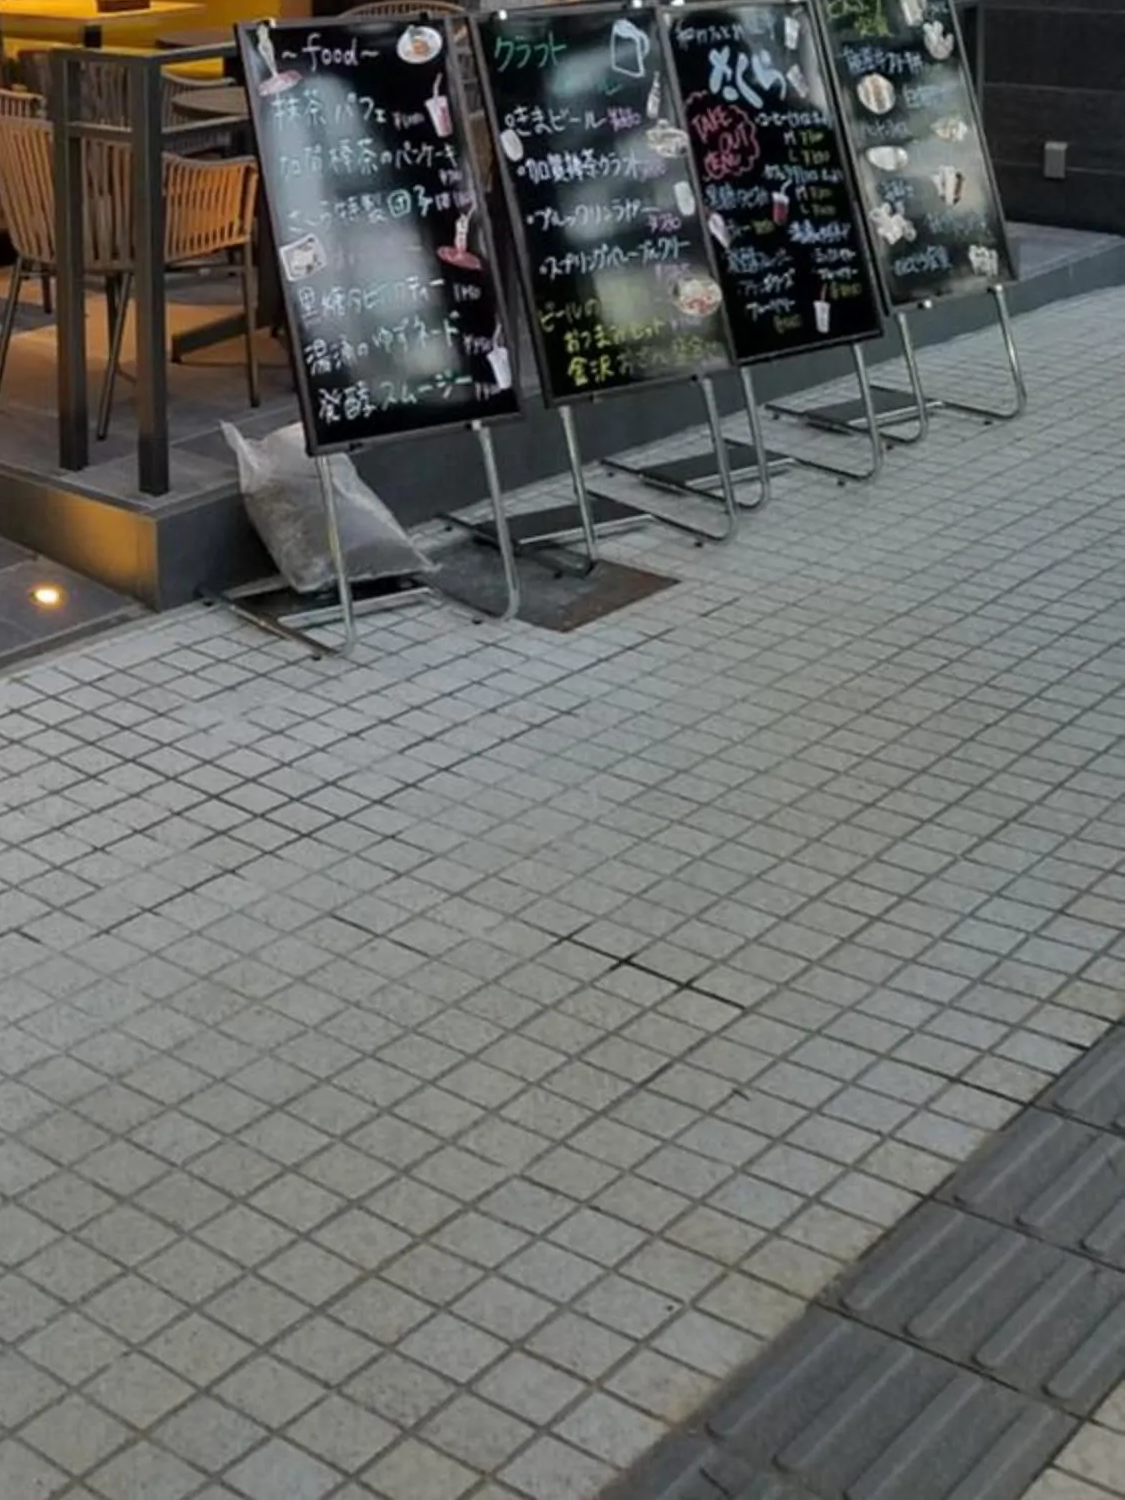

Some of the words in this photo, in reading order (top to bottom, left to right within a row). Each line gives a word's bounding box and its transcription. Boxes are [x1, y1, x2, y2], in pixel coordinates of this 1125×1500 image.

[494, 31, 568, 72] クラフト
[708, 46, 787, 109] さくら
[692, 105, 733, 144] TAKE
[718, 124, 749, 153] OUT
